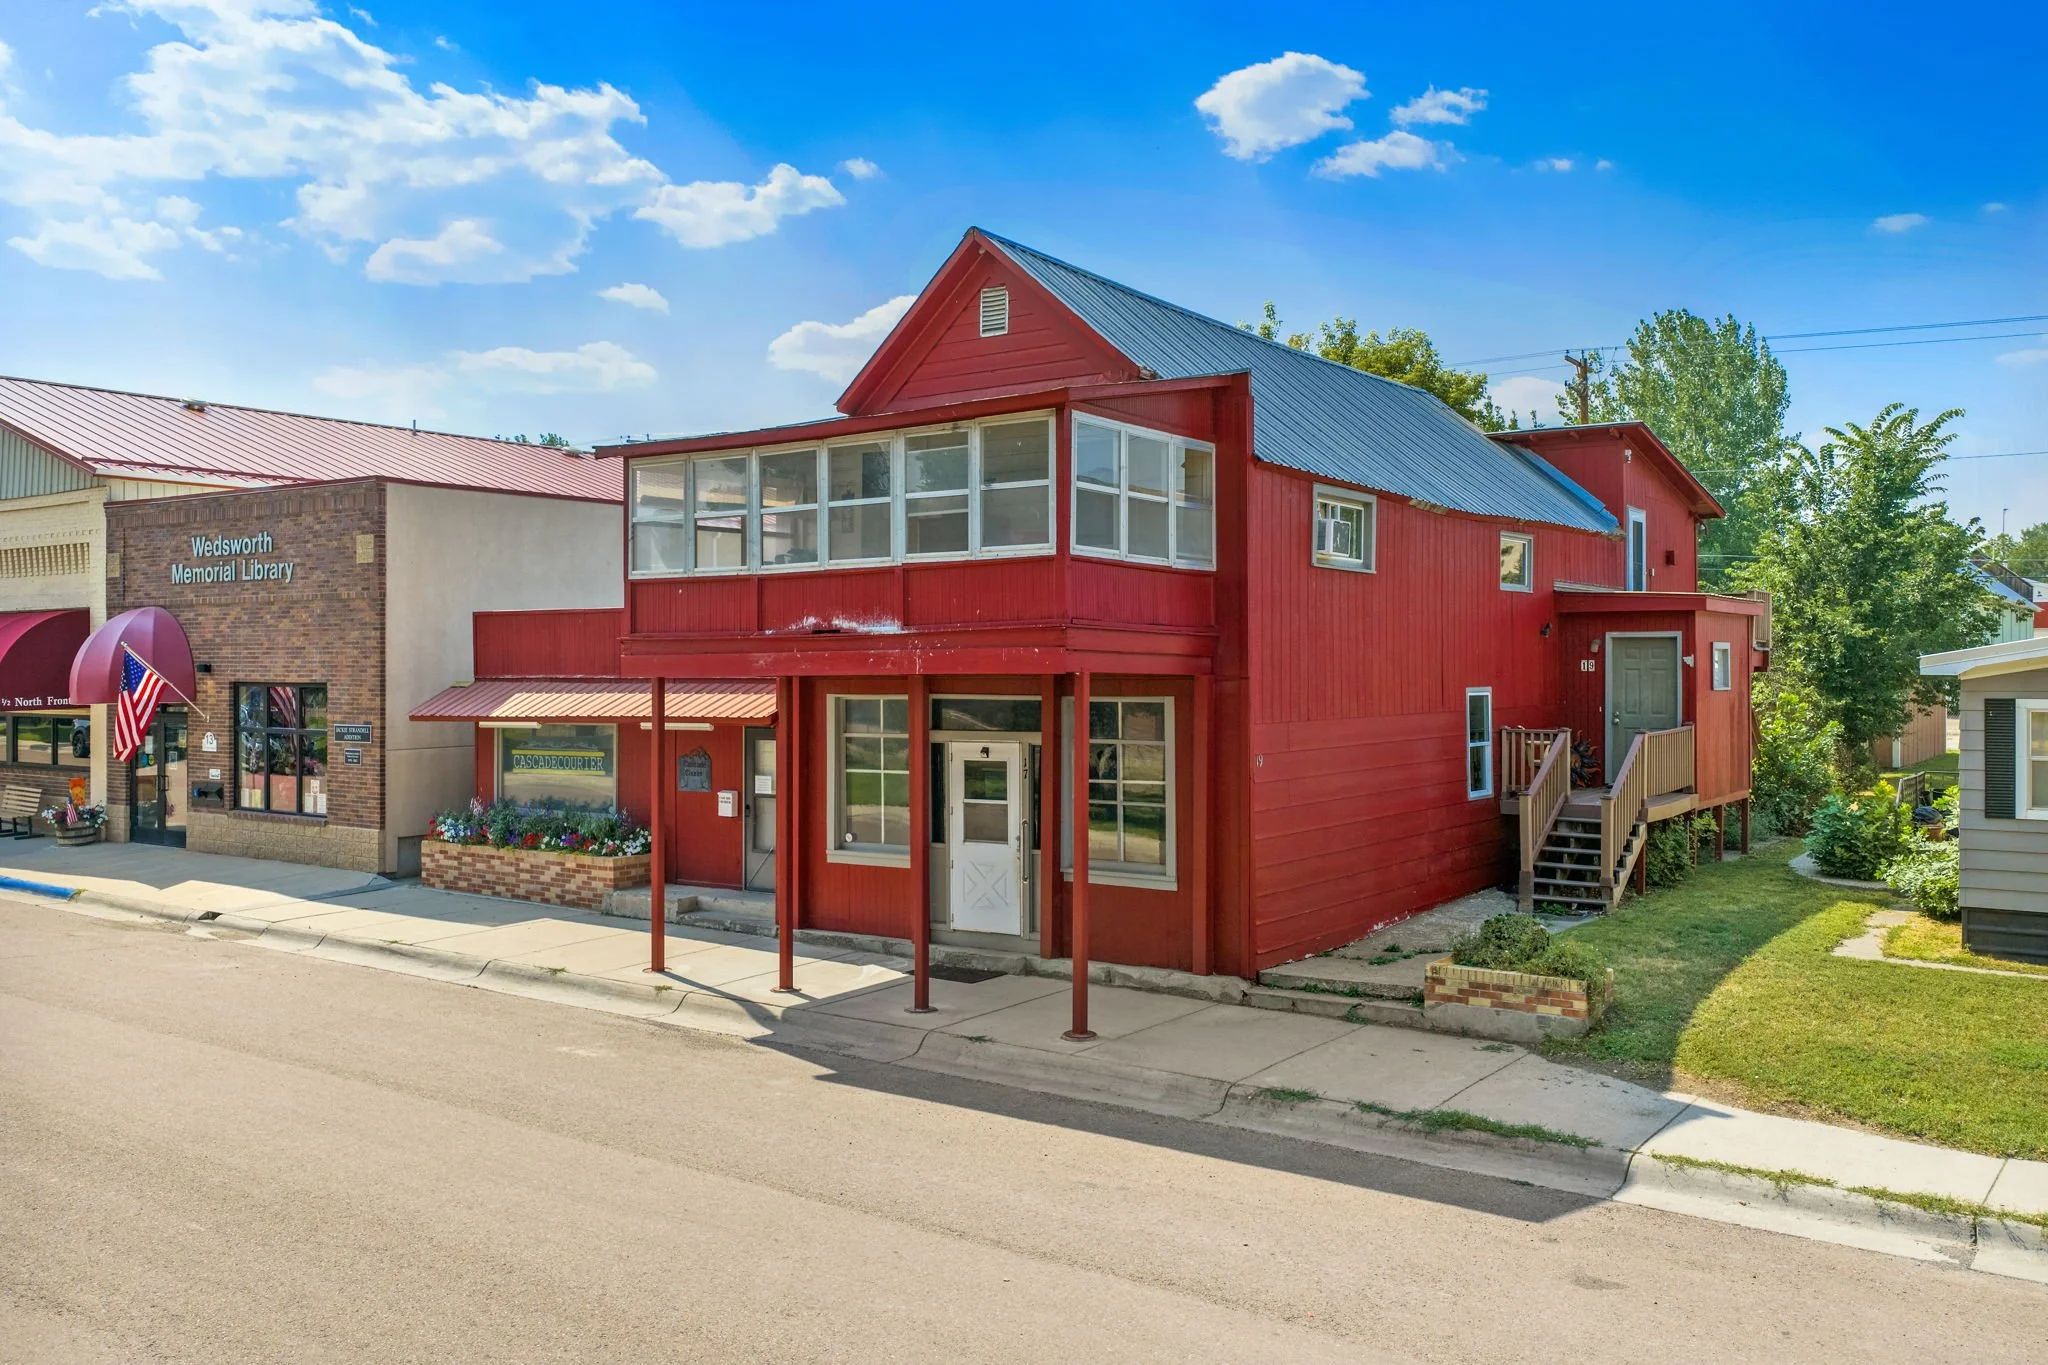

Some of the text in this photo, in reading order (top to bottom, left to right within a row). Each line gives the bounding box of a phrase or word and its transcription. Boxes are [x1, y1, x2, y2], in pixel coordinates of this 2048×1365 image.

[192, 531, 273, 557] Wedsworth
[171, 559, 294, 584] Memorial Library
[1583, 661, 1593, 670] 19
[15, 696, 42, 706] North
[205, 734, 214, 744] 13
